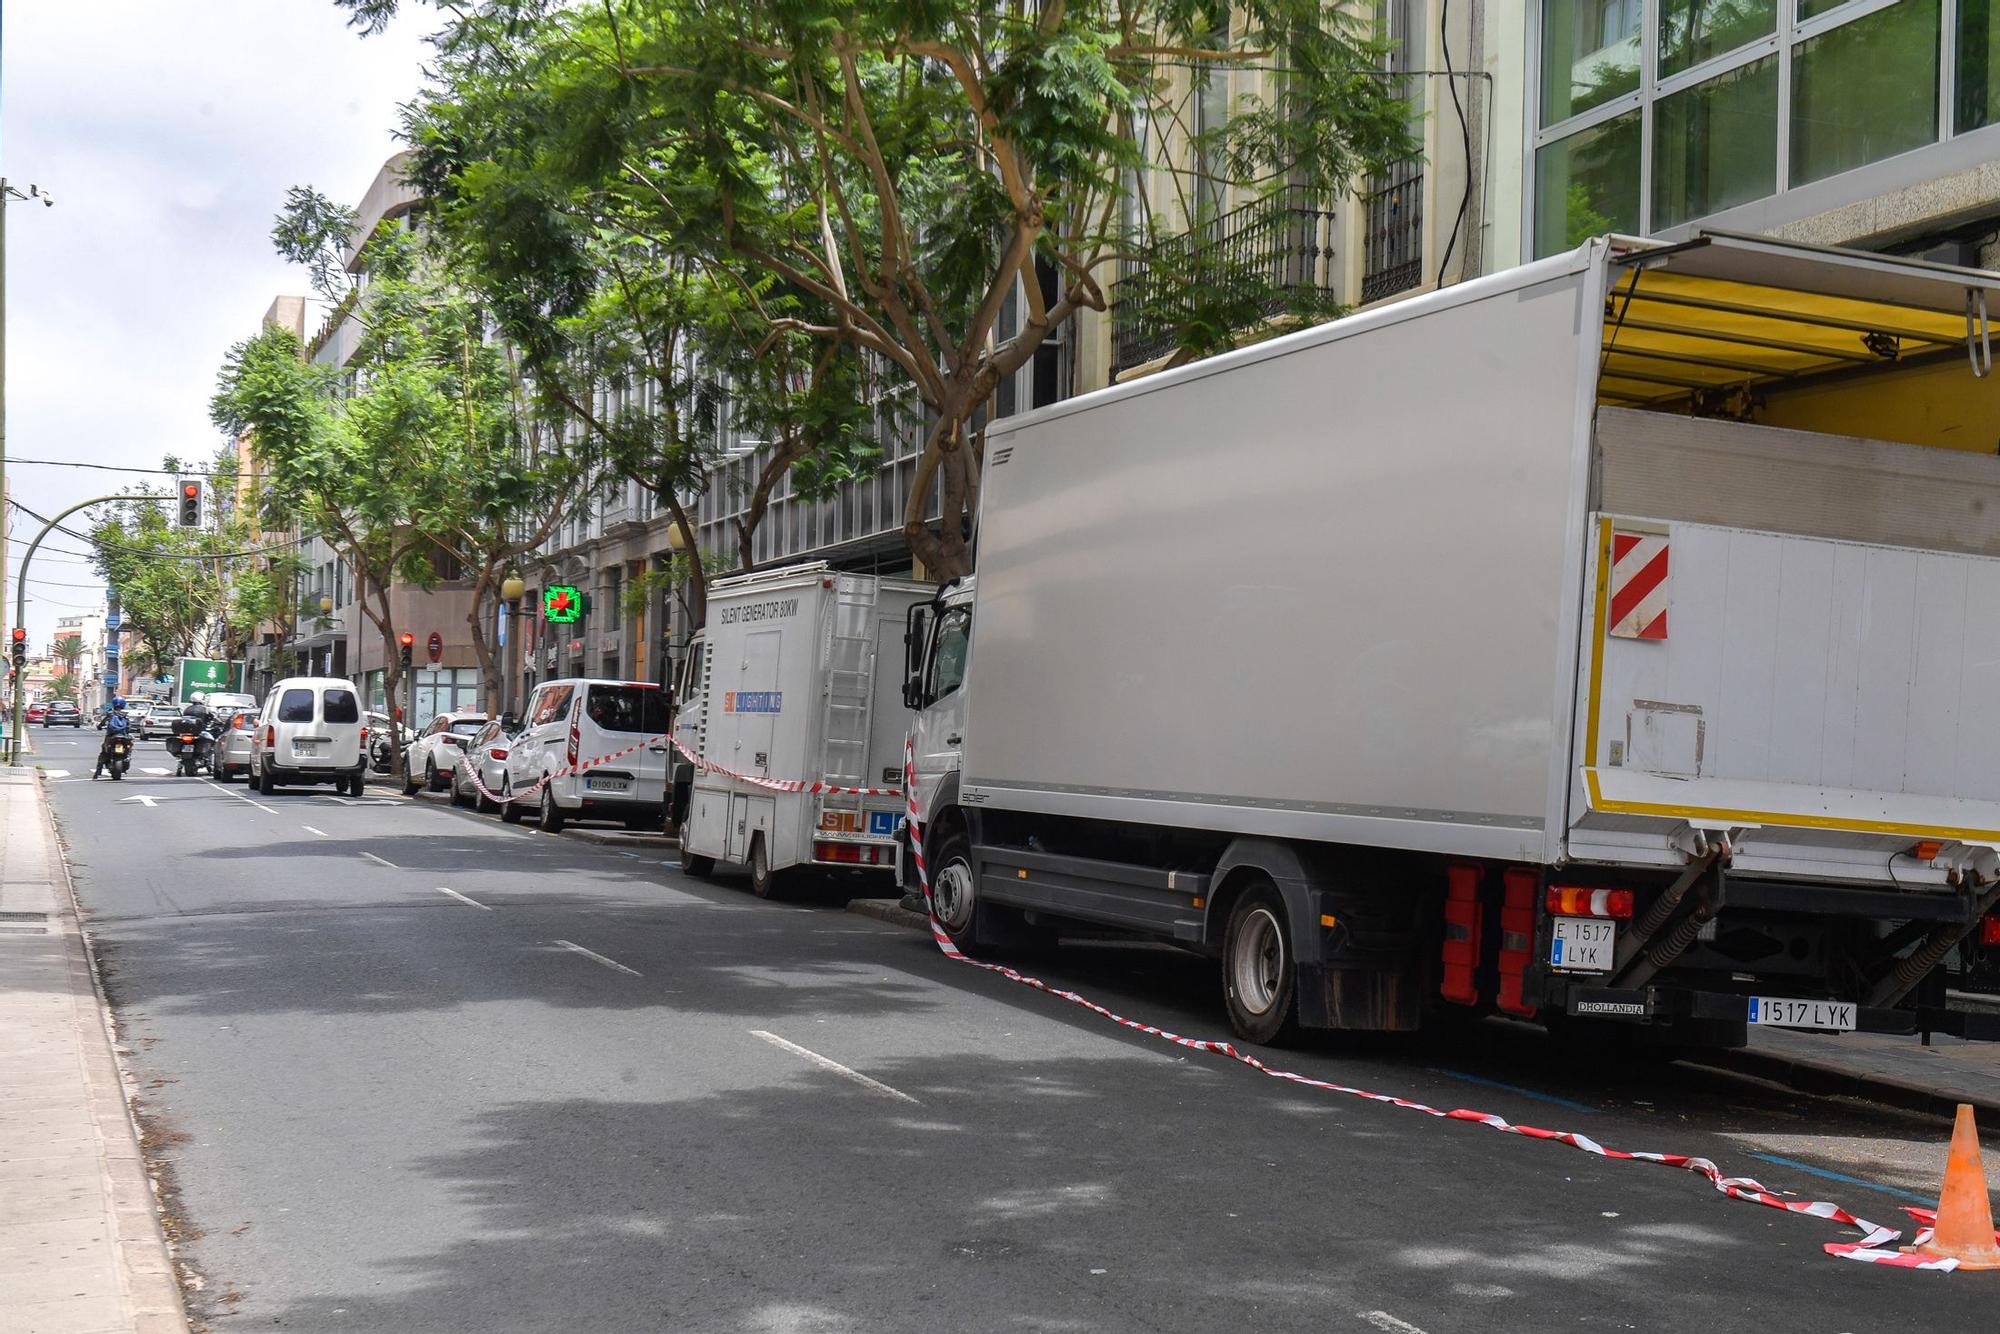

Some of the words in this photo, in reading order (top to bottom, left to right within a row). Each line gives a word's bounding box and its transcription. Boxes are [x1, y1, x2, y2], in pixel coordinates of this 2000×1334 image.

[721, 606, 741, 625] SILENT
[742, 601, 779, 623] GENERATOR
[737, 694, 781, 709] LIGHTING
[1557, 923, 1567, 939] E
[1576, 924, 1611, 942] 1517
[1568, 946, 1597, 964] LYK
[1579, 1002, 1644, 1014] DHOLLANDIA
[1763, 1001, 1808, 1023] 1517
[1814, 1004, 1850, 1026] LYK
